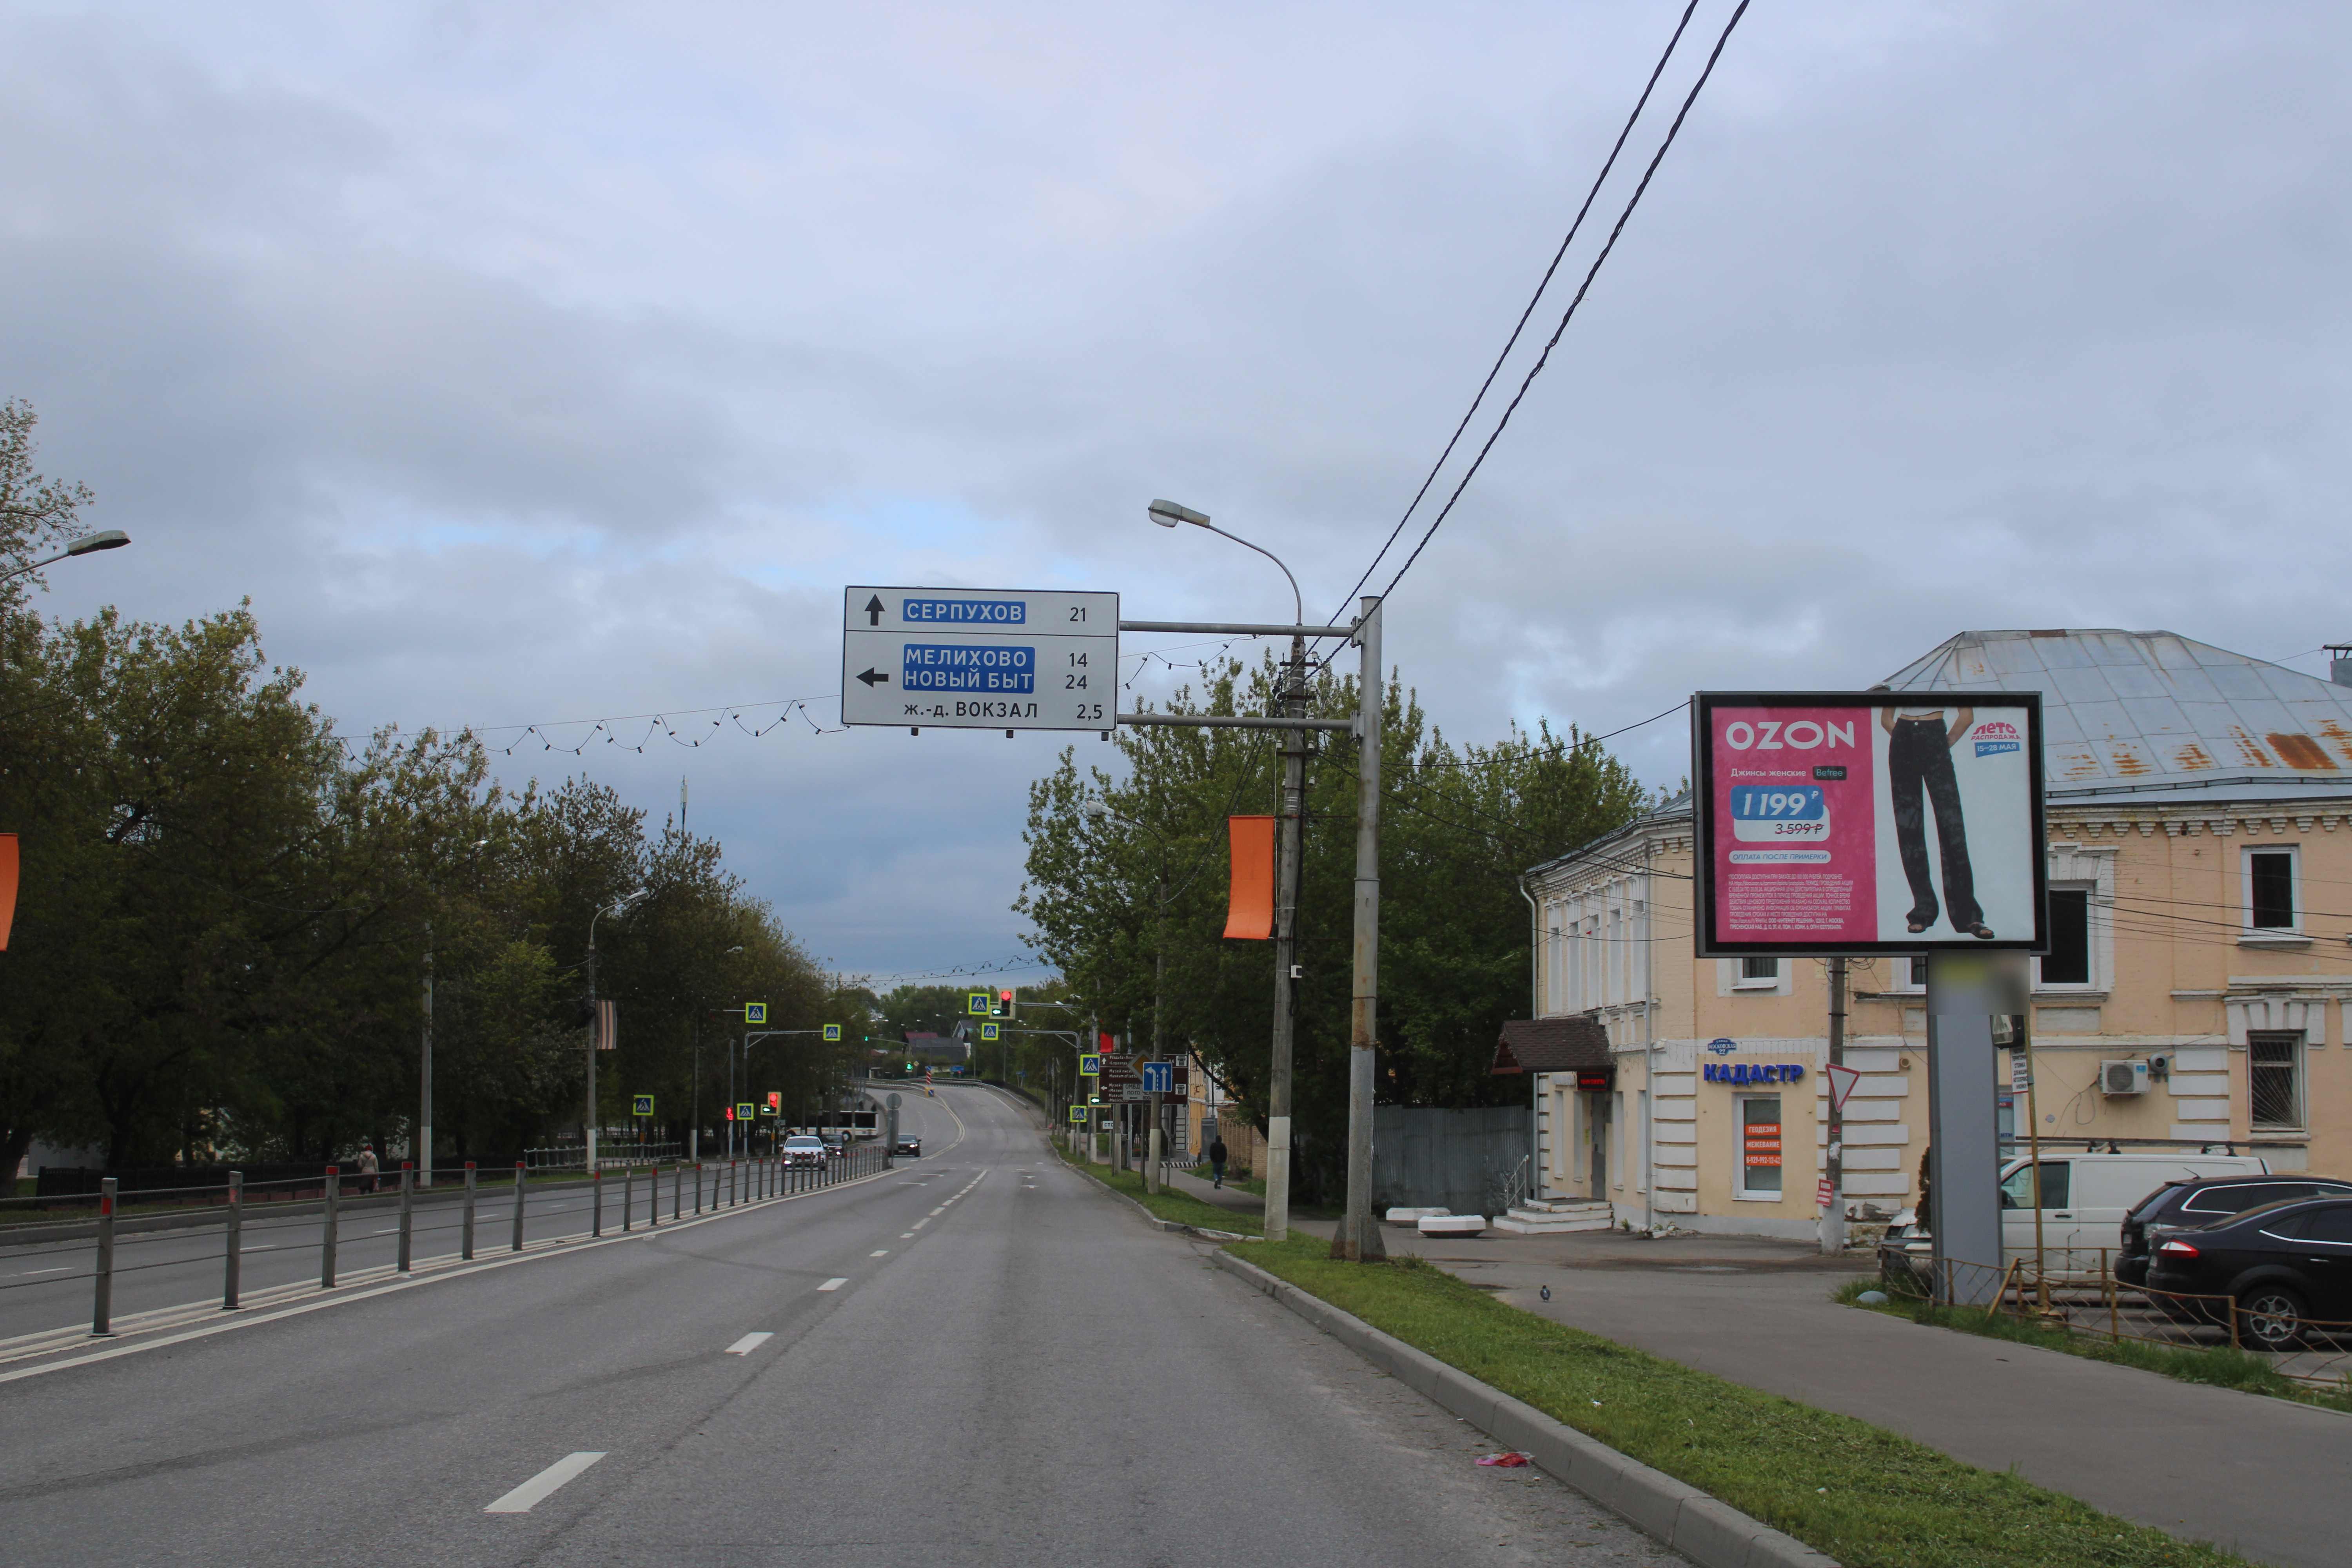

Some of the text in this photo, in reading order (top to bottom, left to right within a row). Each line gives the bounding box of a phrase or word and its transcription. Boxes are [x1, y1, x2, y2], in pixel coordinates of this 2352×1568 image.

[907, 603, 1022, 621] СЕРПУХОВ
[1069, 607, 1087, 622] 21
[906, 649, 1027, 667] МЕЛИХОВО
[1069, 653, 1088, 667] 14
[904, 668, 1032, 689] НОВЫЙ БЫТ
[1065, 675, 1087, 690] 24
[956, 702, 1038, 718] ВОКЗАЛ
[1077, 704, 1103, 721] 2,5
[1726, 720, 1855, 750] OZON
[1731, 768, 1766, 777] Джинсы
[1704, 1063, 1805, 1085] КАДАСТР
